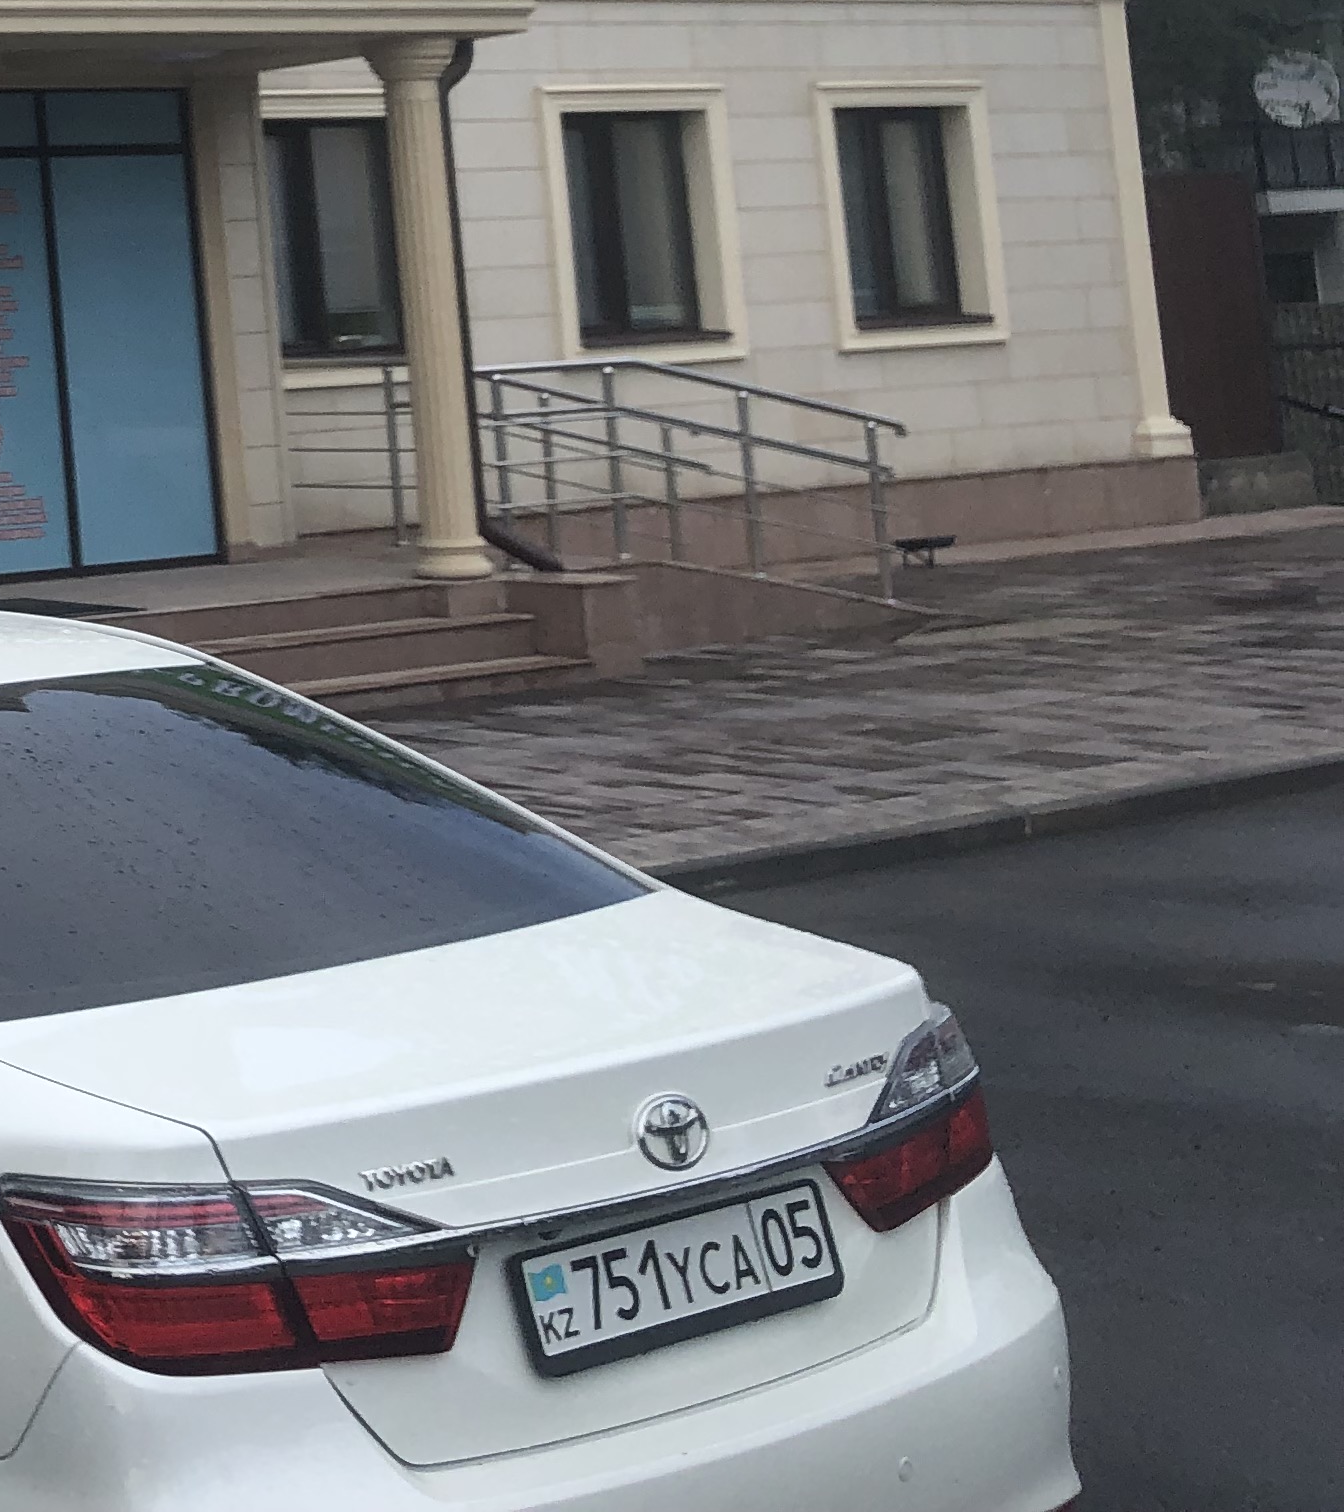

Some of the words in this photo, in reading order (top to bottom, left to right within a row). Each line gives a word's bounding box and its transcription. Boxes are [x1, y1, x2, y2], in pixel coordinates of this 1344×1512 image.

[357, 1156, 455, 1192] TOYOTA
[570, 1233, 760, 1332] 751YCA
[758, 1199, 824, 1278] 05
[538, 1307, 580, 1345] KZ
